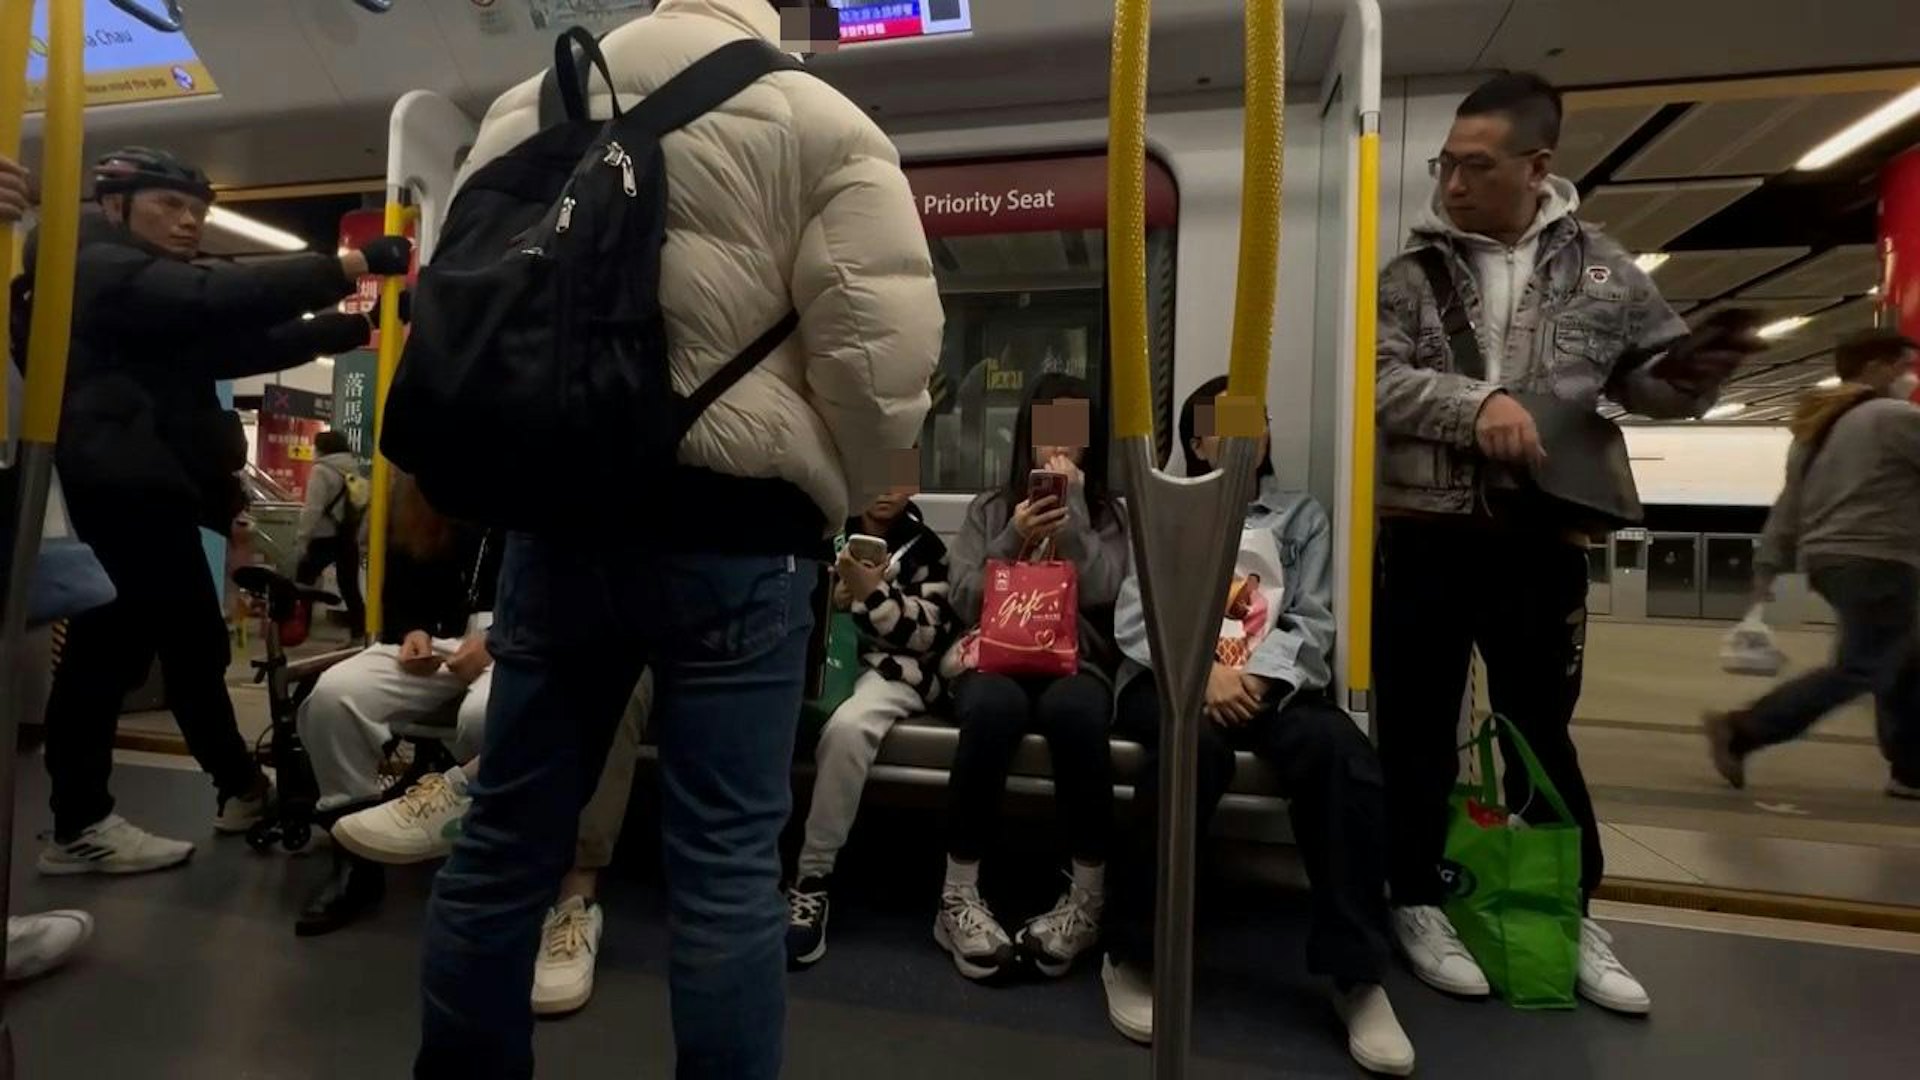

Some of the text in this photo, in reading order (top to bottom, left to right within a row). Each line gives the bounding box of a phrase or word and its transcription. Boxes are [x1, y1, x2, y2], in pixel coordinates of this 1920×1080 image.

[95, 29, 133, 45] Chau
[924, 189, 1056, 217] Priority Seat
[343, 372, 366, 453] 落馬洲
[998, 588, 1060, 628] Gift
